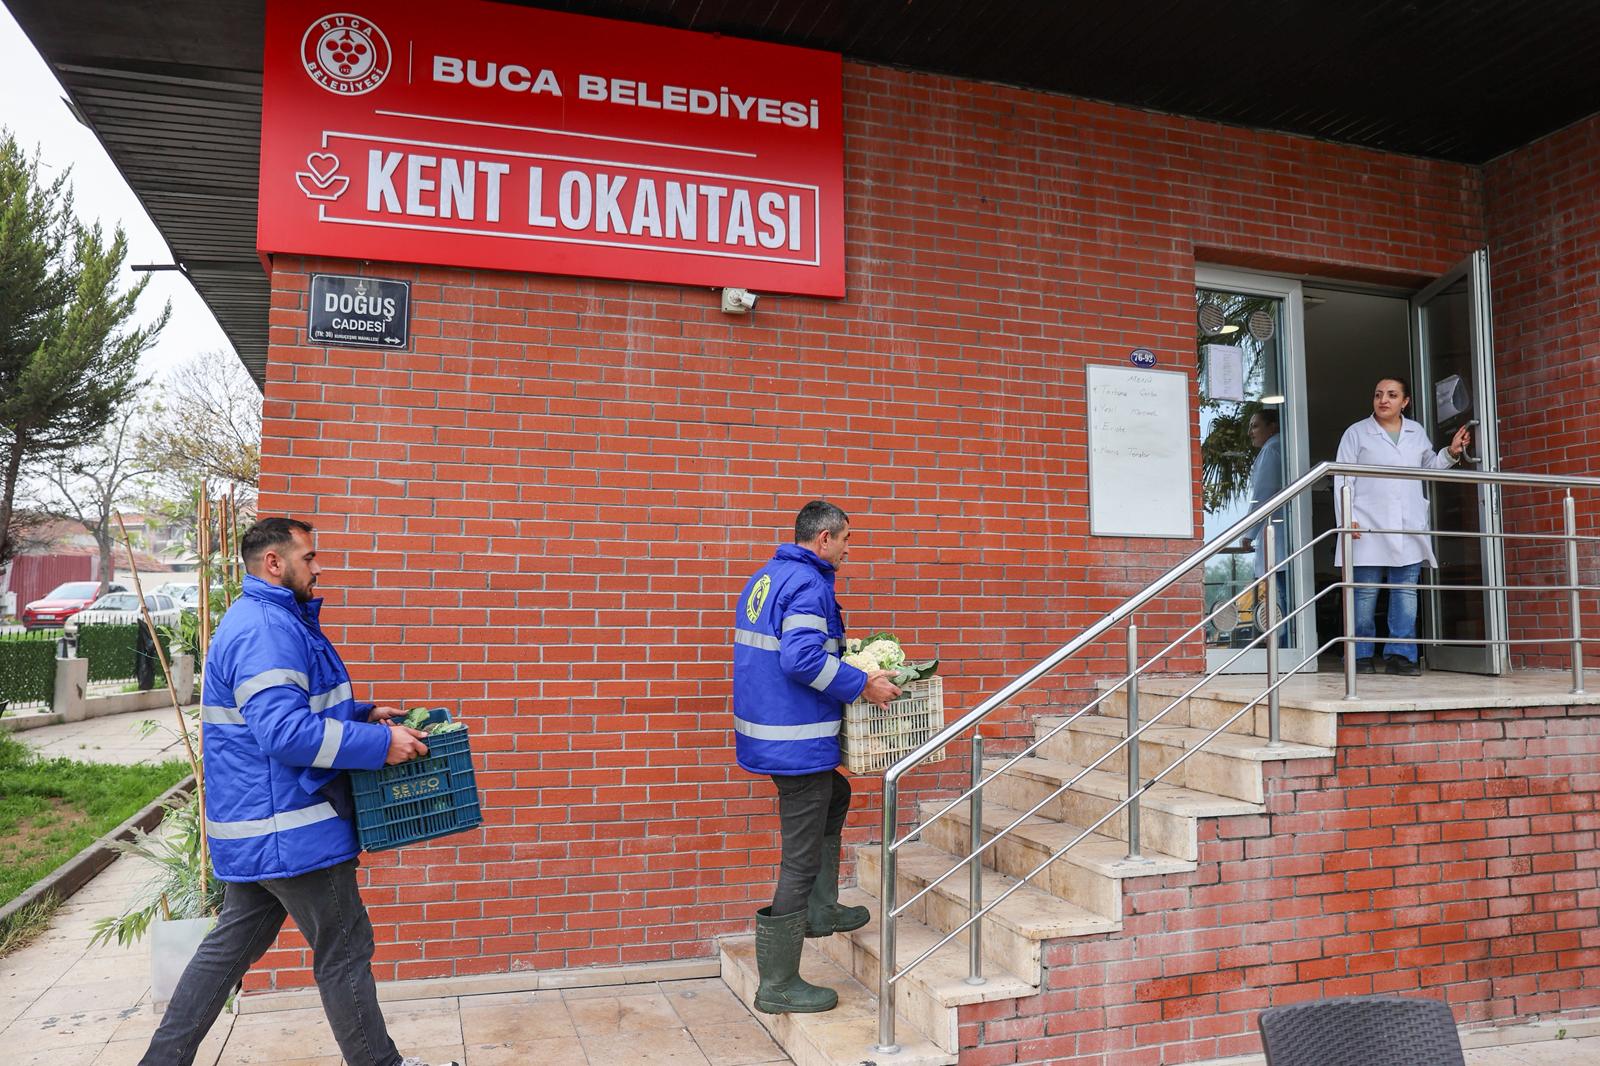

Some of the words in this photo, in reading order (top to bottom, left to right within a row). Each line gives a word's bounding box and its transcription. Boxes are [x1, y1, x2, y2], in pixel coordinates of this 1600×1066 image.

[321, 17, 373, 37] BUCA
[307, 62, 384, 93] BELEDİYESİ
[432, 55, 562, 97] BUCA
[578, 74, 820, 130] BELEDİYESİ
[366, 150, 510, 223] KENT
[528, 166, 801, 252] LOKANTASI
[325, 291, 396, 322] DOĞUŞ
[332, 318, 386, 333] CADDESİ
[1133, 353, 1154, 363] 76-92
